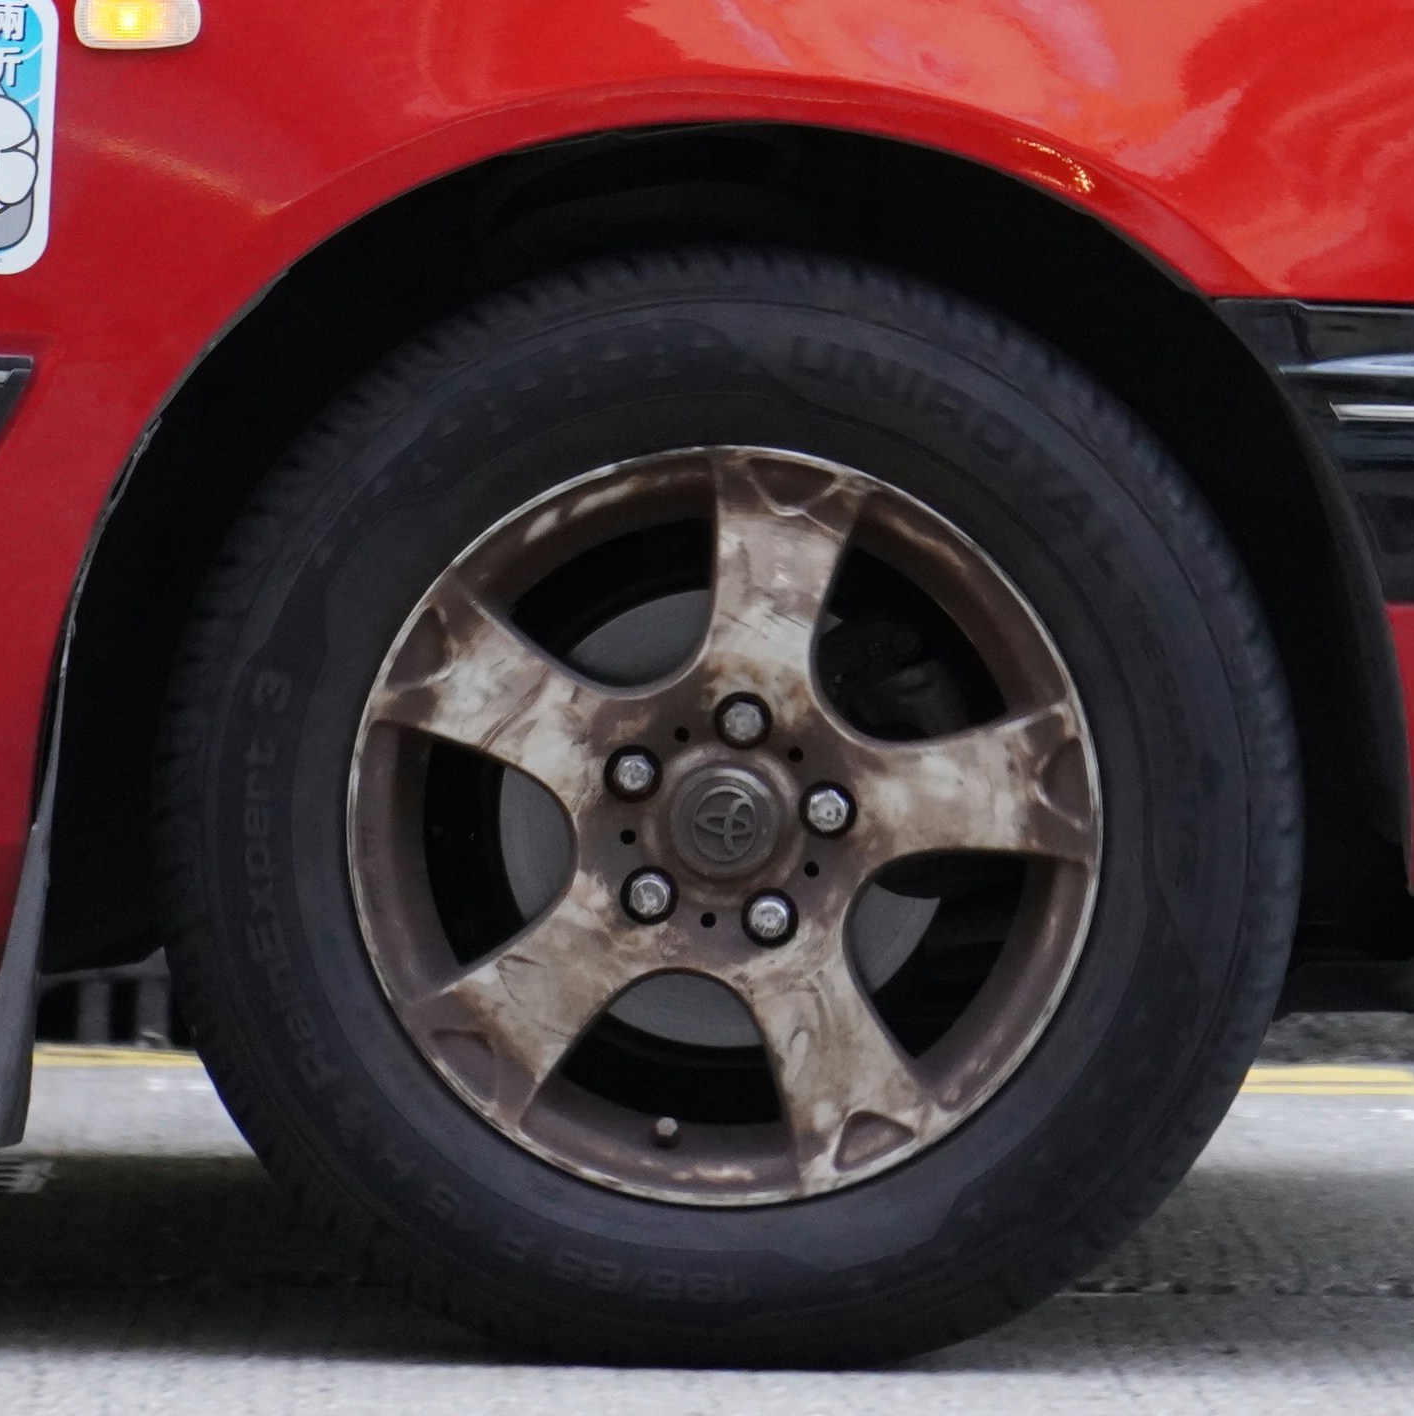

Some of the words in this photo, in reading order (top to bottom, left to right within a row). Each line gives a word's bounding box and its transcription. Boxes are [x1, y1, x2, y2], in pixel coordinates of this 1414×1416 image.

[787, 336, 1125, 582] UNIROYAL
[250, 669, 293, 715] 3
[241, 735, 343, 1093] RainExpert
